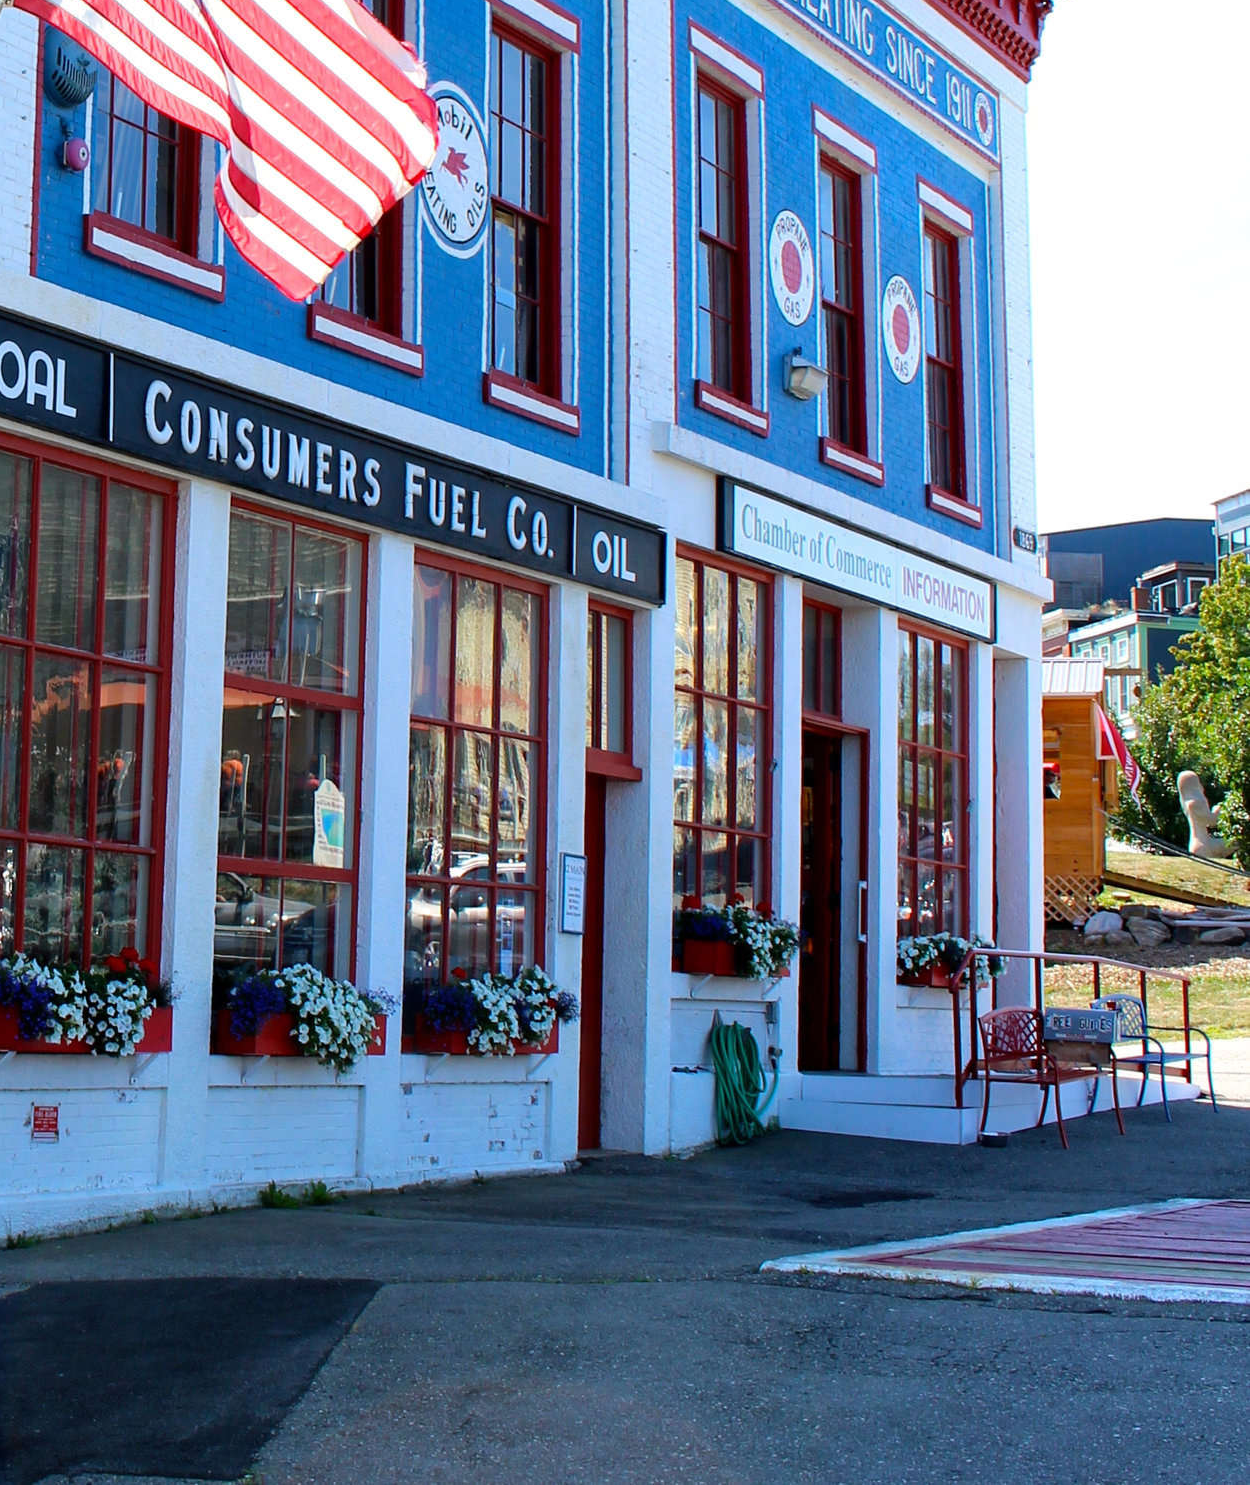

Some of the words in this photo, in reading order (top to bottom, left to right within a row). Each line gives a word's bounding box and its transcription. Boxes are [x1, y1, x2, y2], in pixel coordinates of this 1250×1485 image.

[885, 24, 937, 106] SINCE
[945, 70, 971, 131] 1911
[424, 167, 457, 234] EATING
[466, 181, 486, 228] OILS
[776, 215, 810, 258] PROPANE
[783, 296, 801, 320] GAS
[893, 356, 909, 378] GAS
[144, 379, 382, 509] CONSUMERS
[403, 461, 487, 539] FUEL
[507, 495, 554, 559] CO.
[591, 530, 637, 583] OIL
[741, 503, 807, 559] Chamber
[809, 531, 825, 565] of
[825, 536, 892, 589] Commerce
[902, 566, 986, 624] INFORMATION
